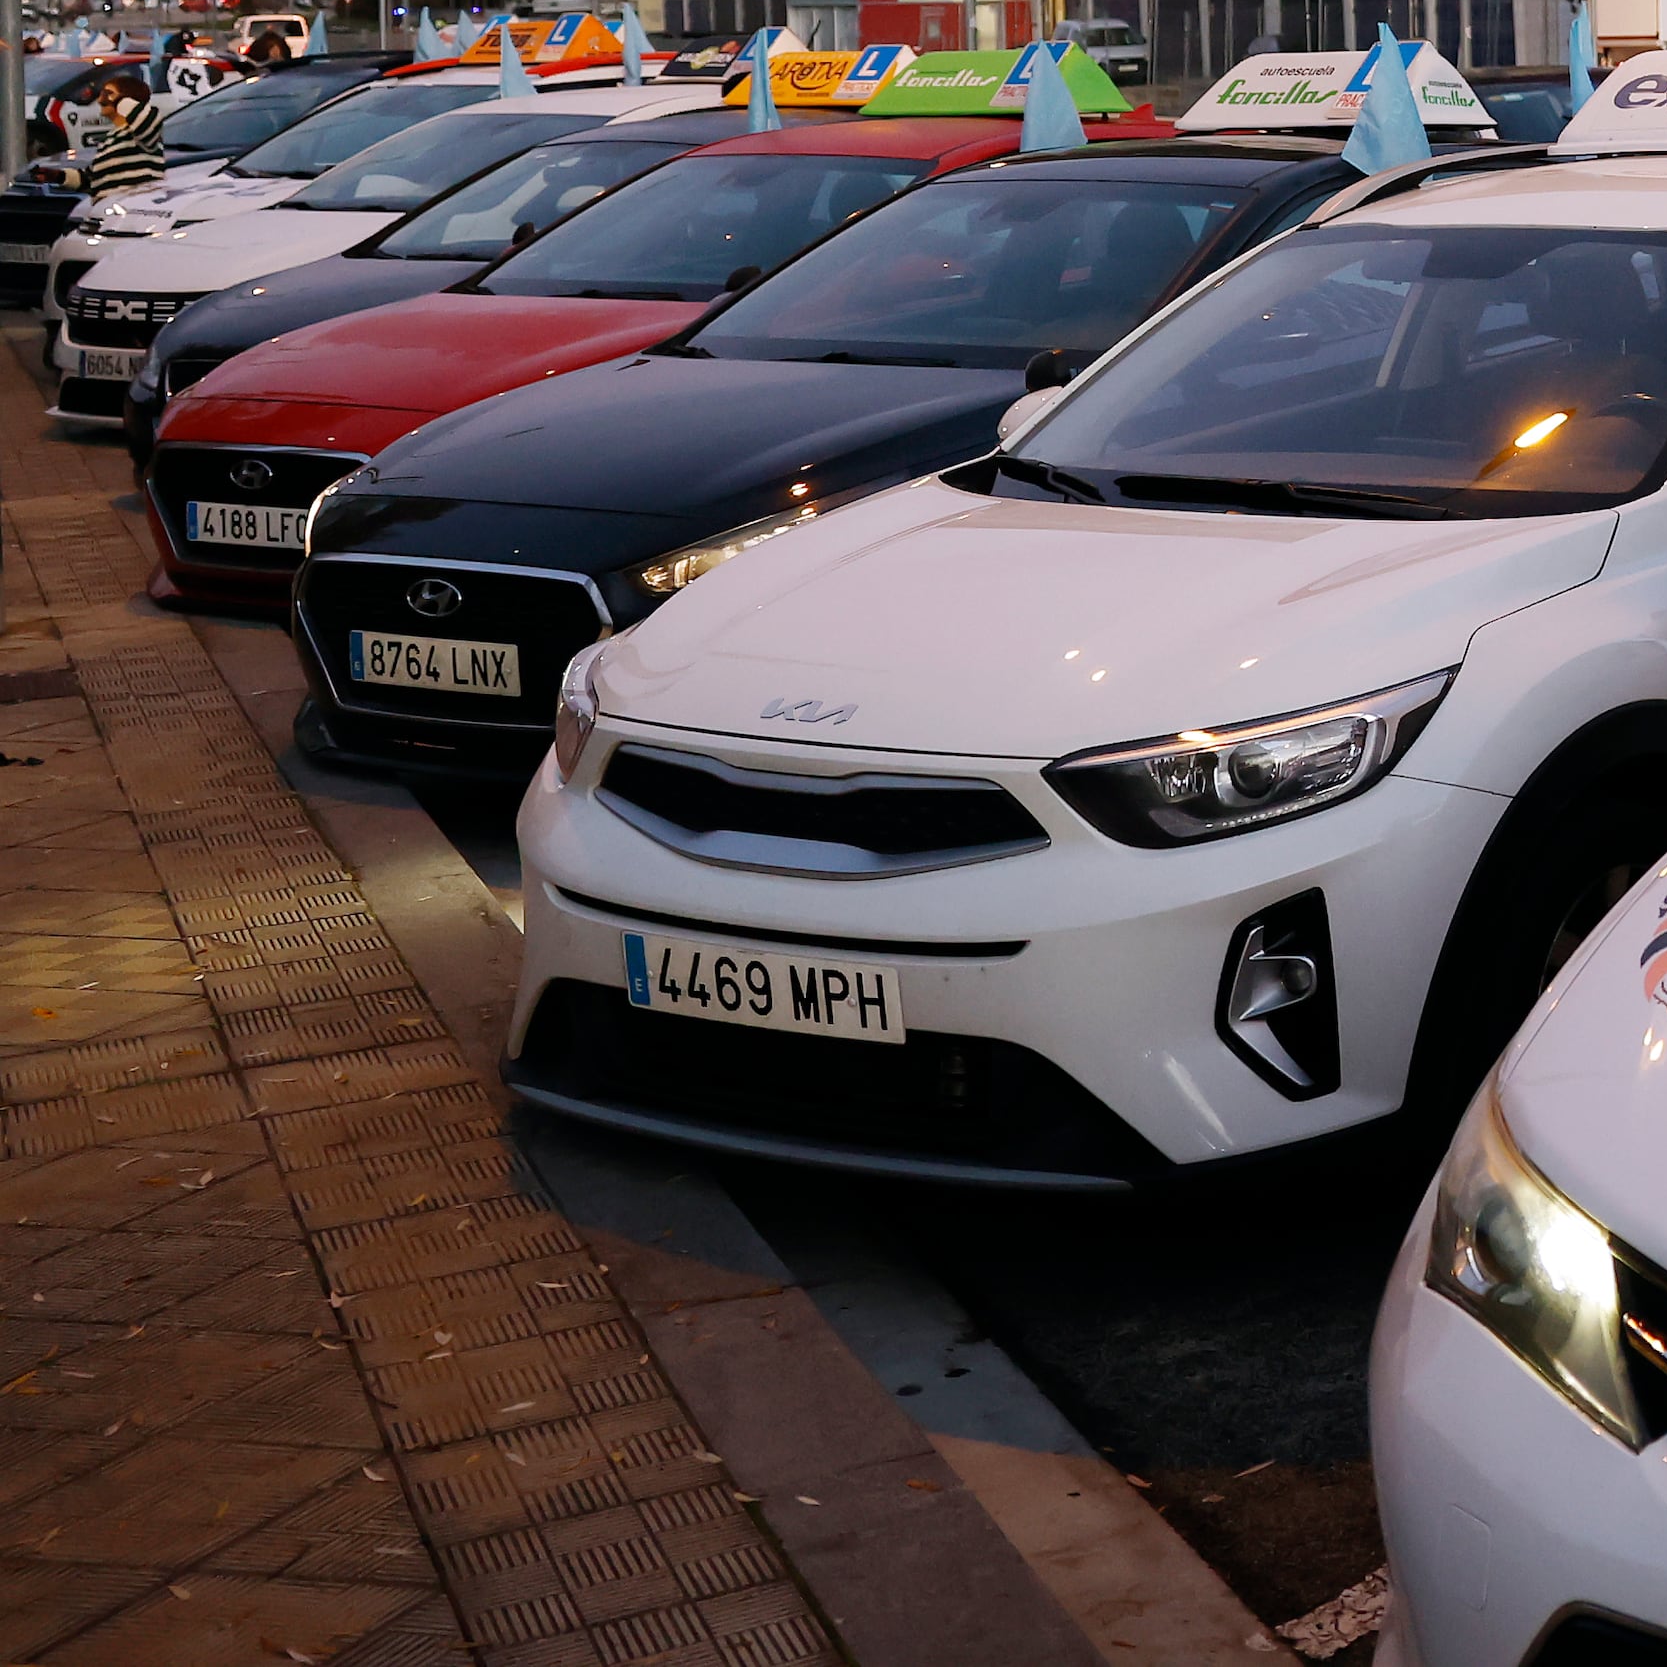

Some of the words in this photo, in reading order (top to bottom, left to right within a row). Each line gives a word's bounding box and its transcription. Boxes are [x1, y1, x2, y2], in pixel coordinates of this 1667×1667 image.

[856, 50, 880, 77] L
[1260, 65, 1335, 77] autoescuela
[204, 507, 257, 540] 4188
[370, 640, 440, 682] 8764
[452, 647, 508, 688] LNX
[659, 947, 773, 1016] 4469
[789, 964, 888, 1030] MPH
